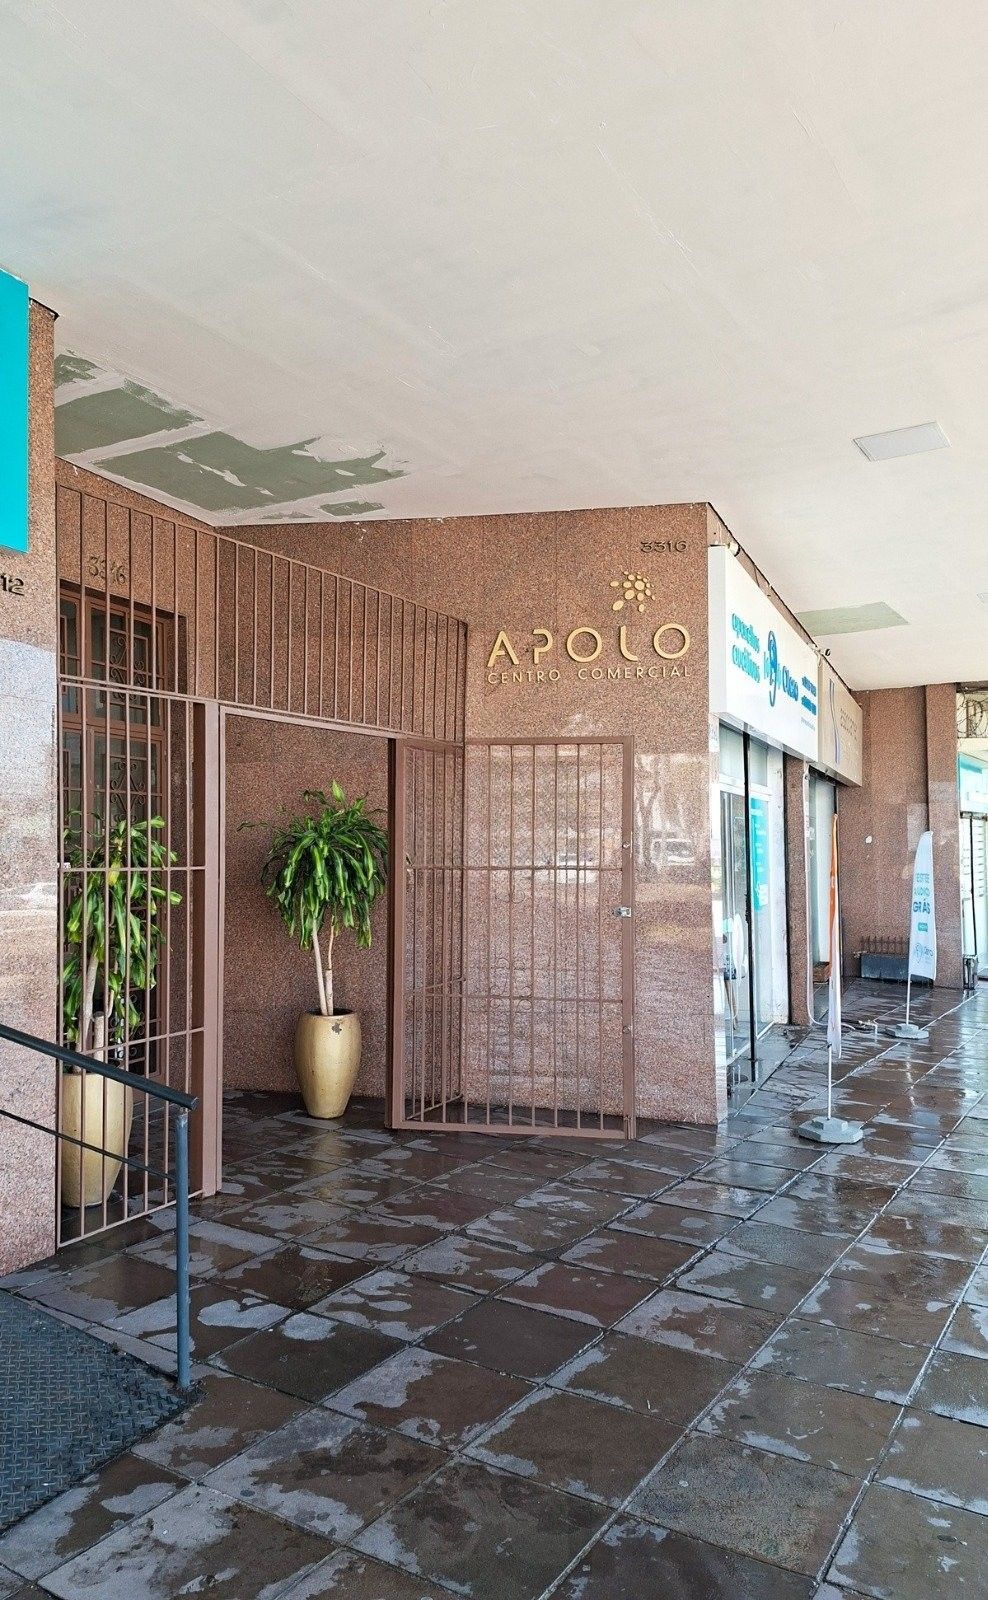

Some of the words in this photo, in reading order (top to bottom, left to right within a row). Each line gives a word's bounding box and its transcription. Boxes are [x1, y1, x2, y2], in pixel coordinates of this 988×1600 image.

[640, 540, 688, 553] 3316
[487, 623, 691, 668] APOLO
[487, 669, 561, 684] CENTRO
[577, 665, 692, 680] COMERCIAL
